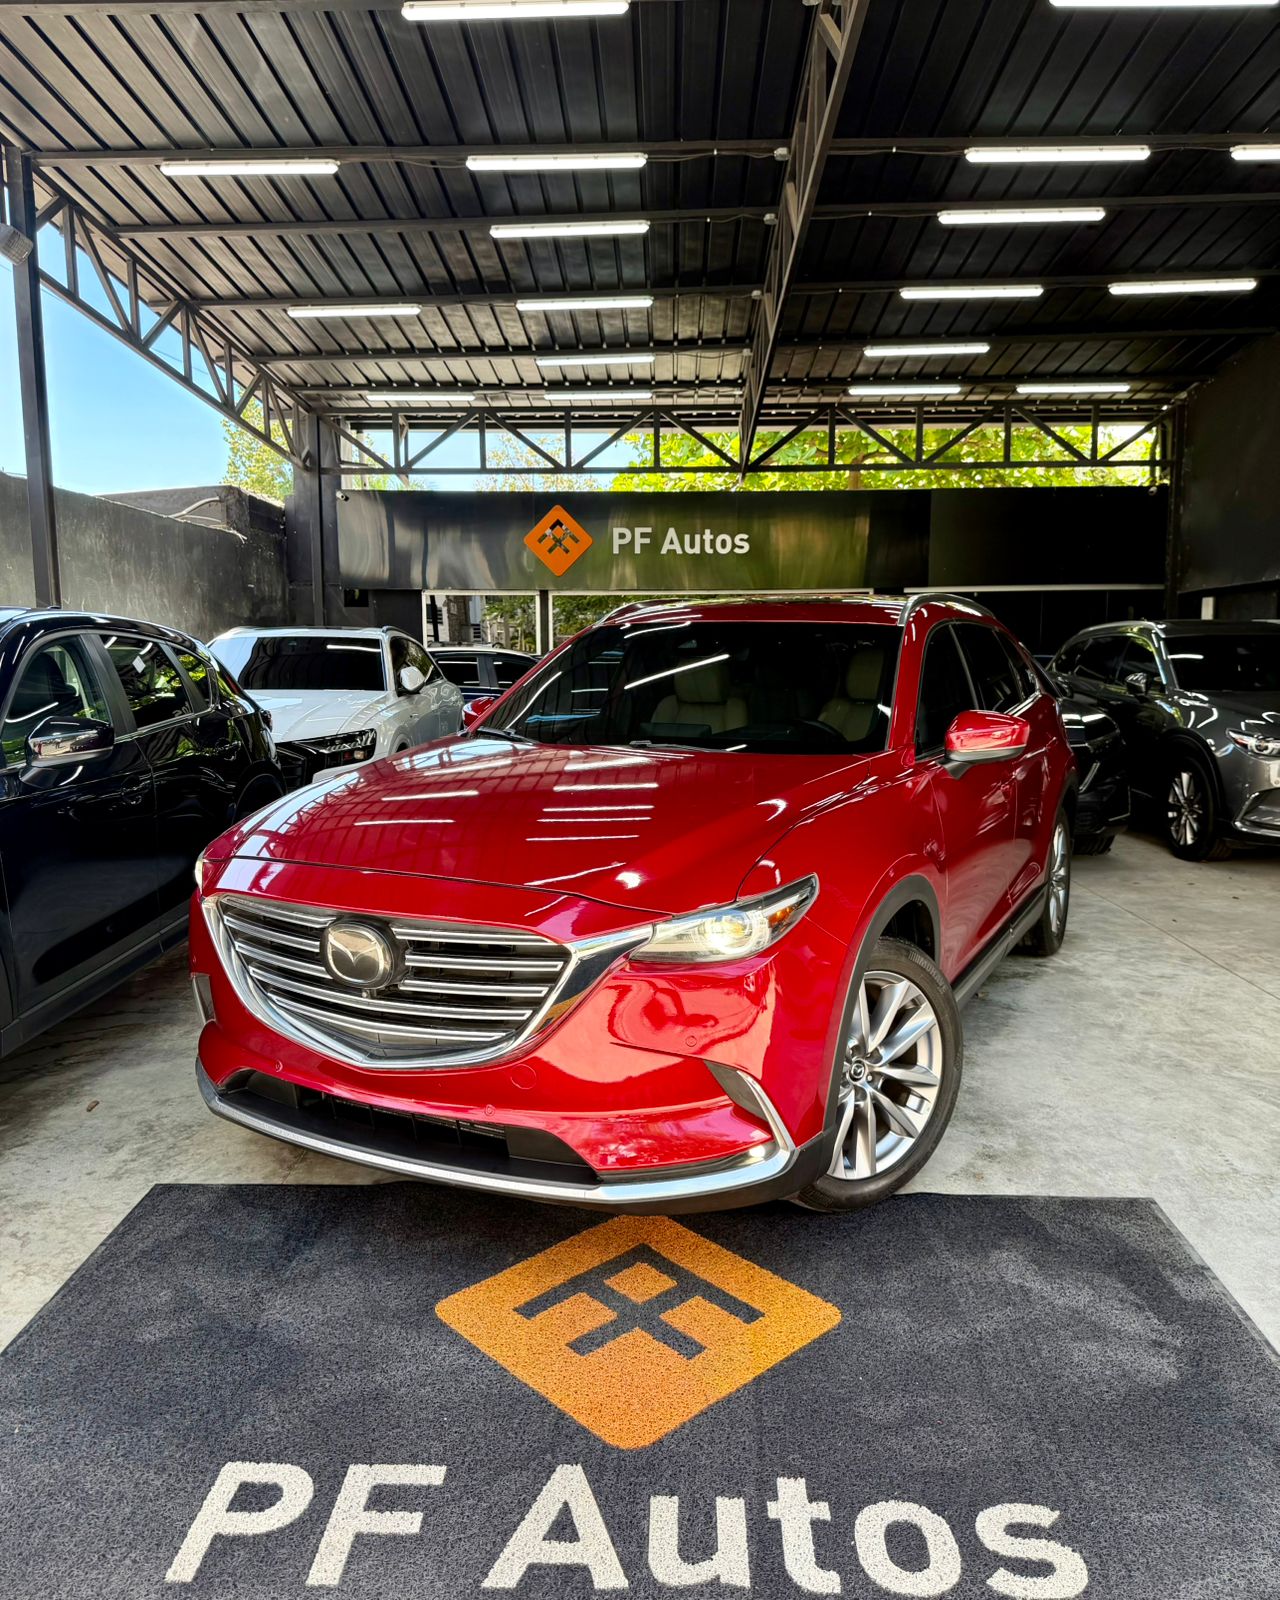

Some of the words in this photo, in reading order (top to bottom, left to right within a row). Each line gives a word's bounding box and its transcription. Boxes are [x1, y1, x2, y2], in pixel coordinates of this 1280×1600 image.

[612, 527, 652, 555] PF
[660, 527, 750, 555] Autos
[164, 1461, 447, 1588] PF
[481, 1463, 1090, 1600] Autos
